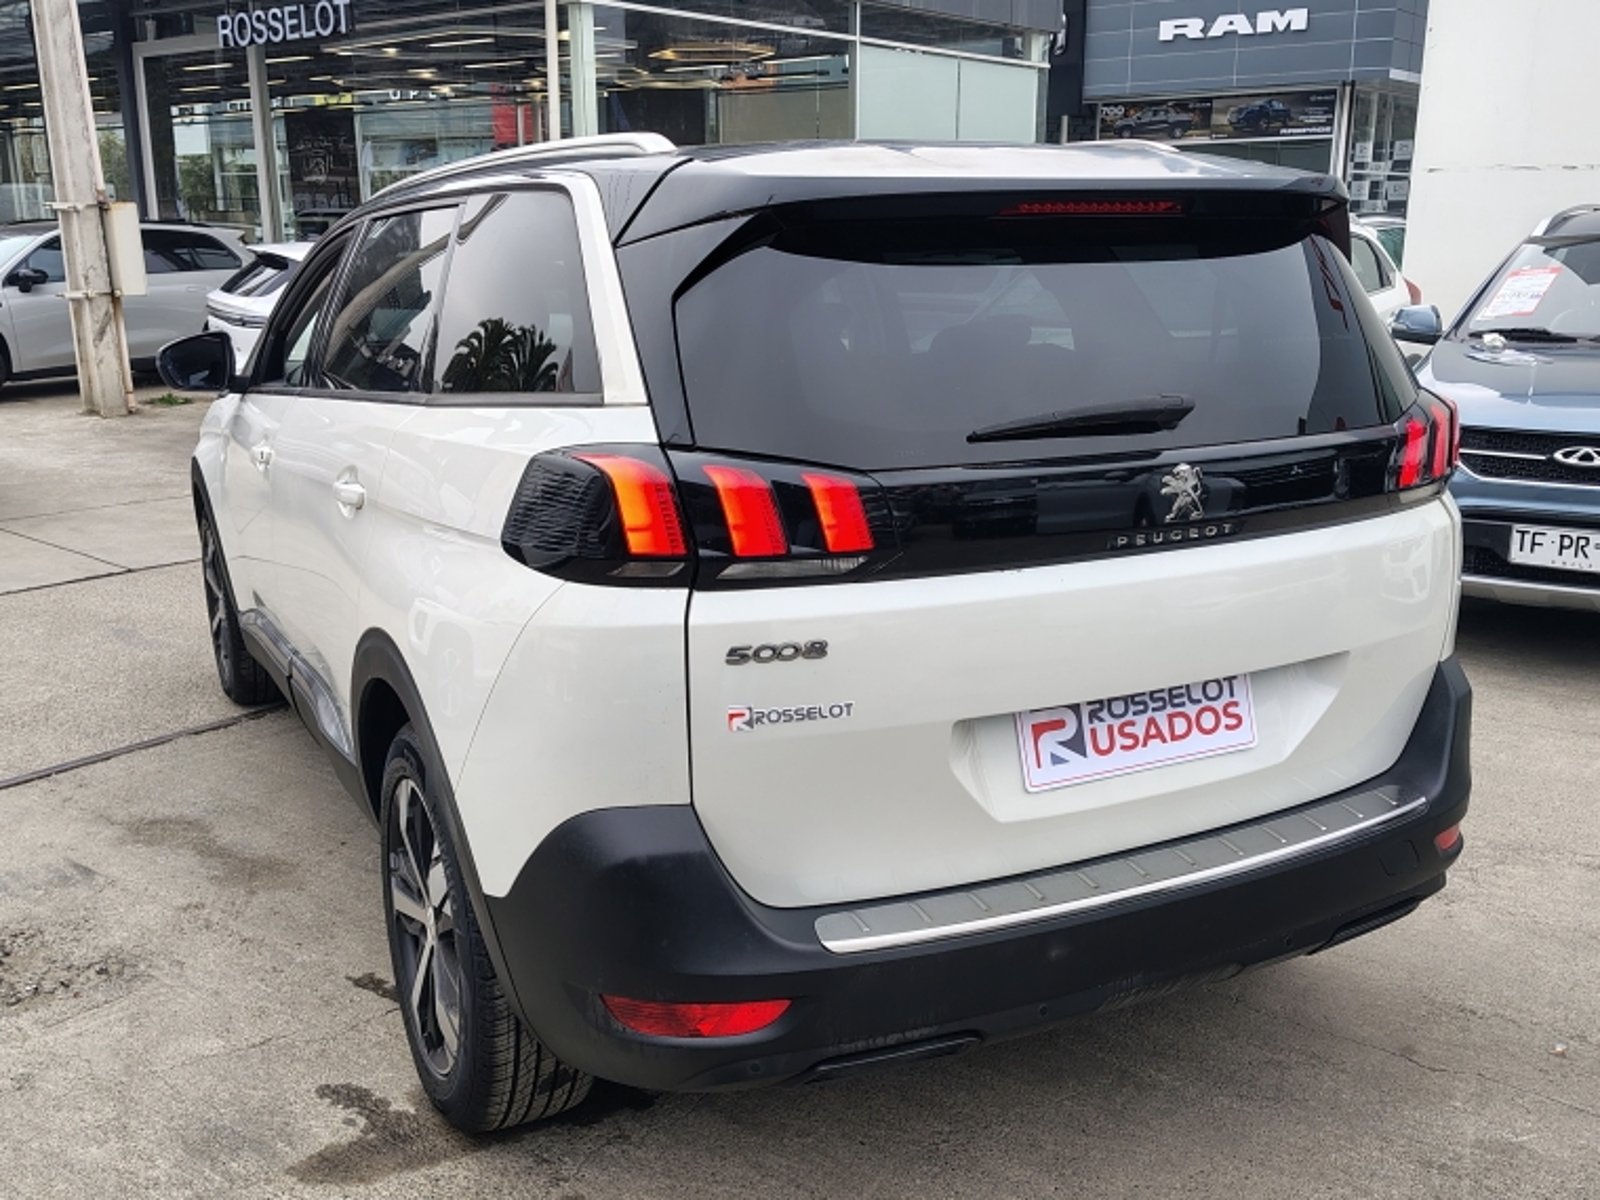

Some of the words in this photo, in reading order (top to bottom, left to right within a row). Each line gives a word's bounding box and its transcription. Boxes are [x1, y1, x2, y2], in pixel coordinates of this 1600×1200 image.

[217, 0, 349, 48] ROSSELOT
[1159, 8, 1308, 41] RAM
[1117, 523, 1232, 549] PEUGEOT
[725, 640, 828, 666] 5008
[755, 702, 853, 725] ROSSELOT
[1087, 675, 1238, 724] ROSSELOT
[1090, 701, 1243, 756] USADOS
